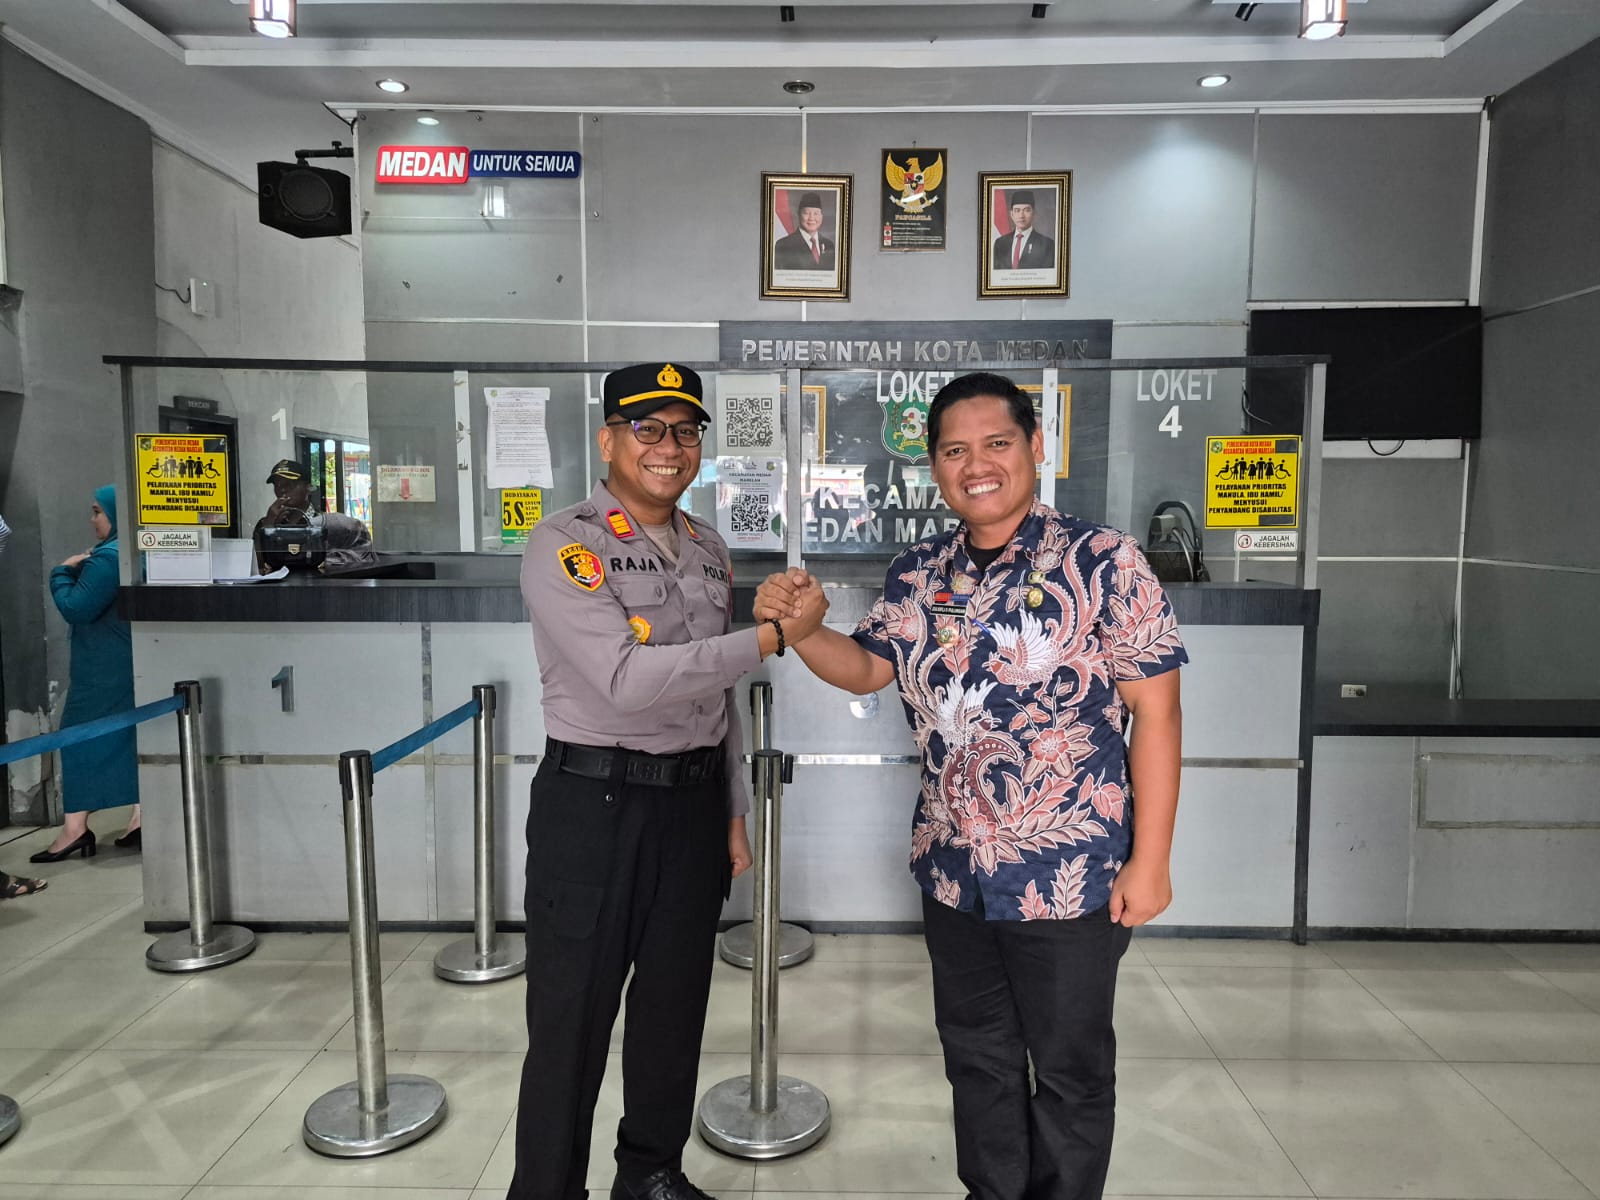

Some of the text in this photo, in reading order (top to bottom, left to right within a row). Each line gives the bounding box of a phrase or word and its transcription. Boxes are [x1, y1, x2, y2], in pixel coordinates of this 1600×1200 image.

[379, 151, 575, 177] MEDAN UNTUK SEMUA
[742, 339, 1088, 362] PEMERINTAH KOTA MEDAN
[1137, 368, 1218, 401] LOKET
[271, 407, 288, 440] 1
[901, 407, 922, 439] 3
[1159, 405, 1182, 438] 4
[819, 483, 951, 509] KECAMA
[802, 517, 884, 543] EDAN
[609, 557, 659, 573] RAJA
[271, 665, 295, 713] 1
